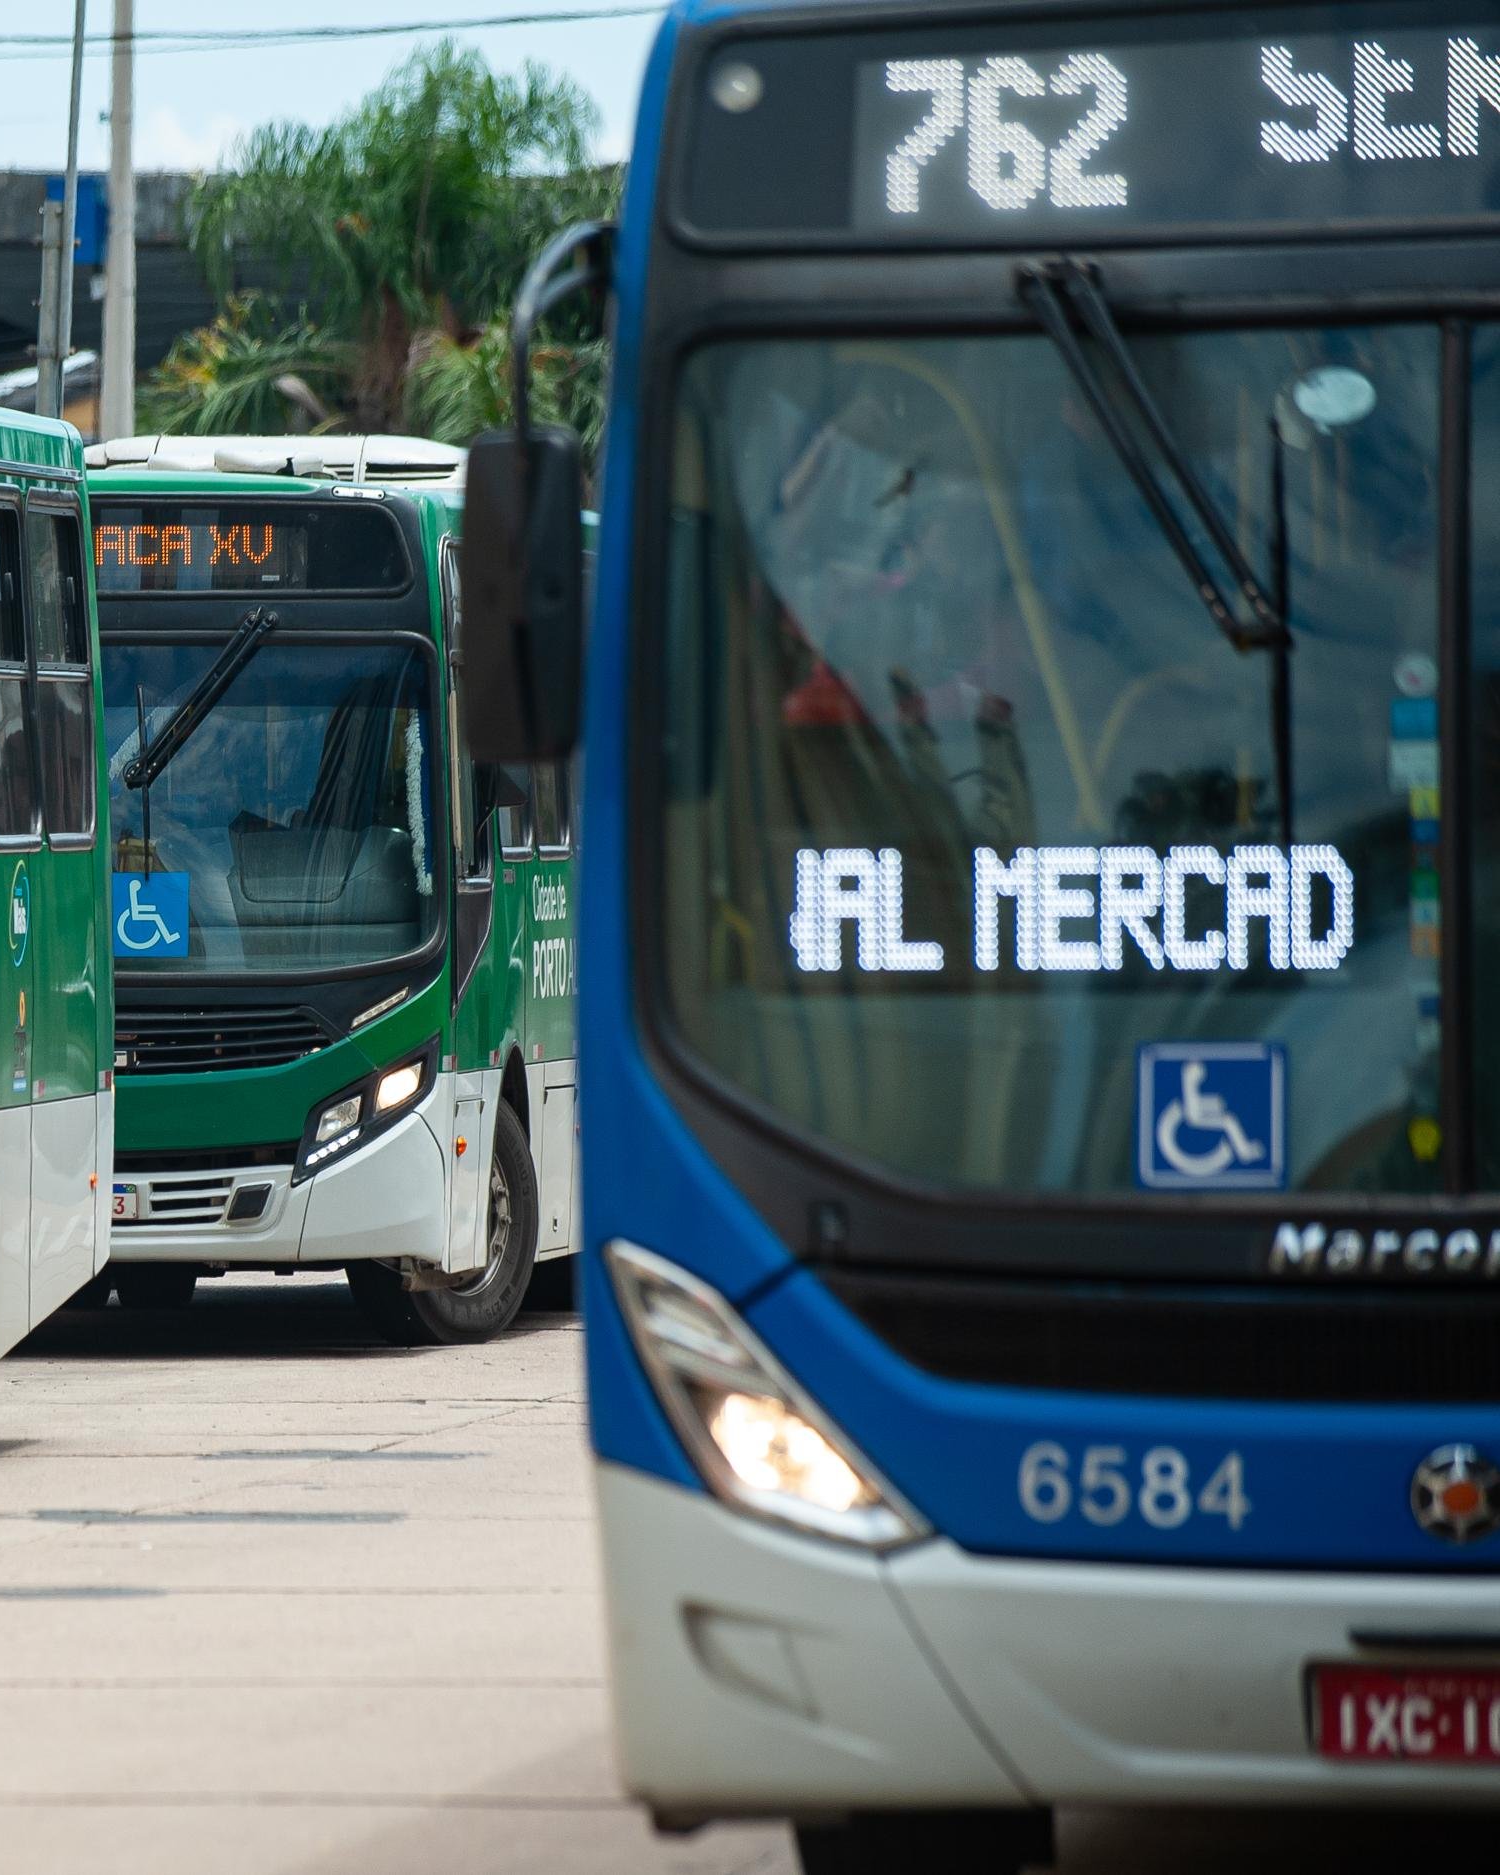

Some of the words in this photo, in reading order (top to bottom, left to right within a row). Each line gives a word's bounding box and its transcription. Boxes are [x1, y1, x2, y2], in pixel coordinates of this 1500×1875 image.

[886, 53, 1128, 213] 762
[209, 524, 274, 566] XV
[532, 874, 557, 922] Cidade
[557, 874, 567, 920] de
[974, 845, 1354, 970] MERCAD
[533, 937, 567, 999] PORTO
[1018, 1440, 1252, 1531] 6584
